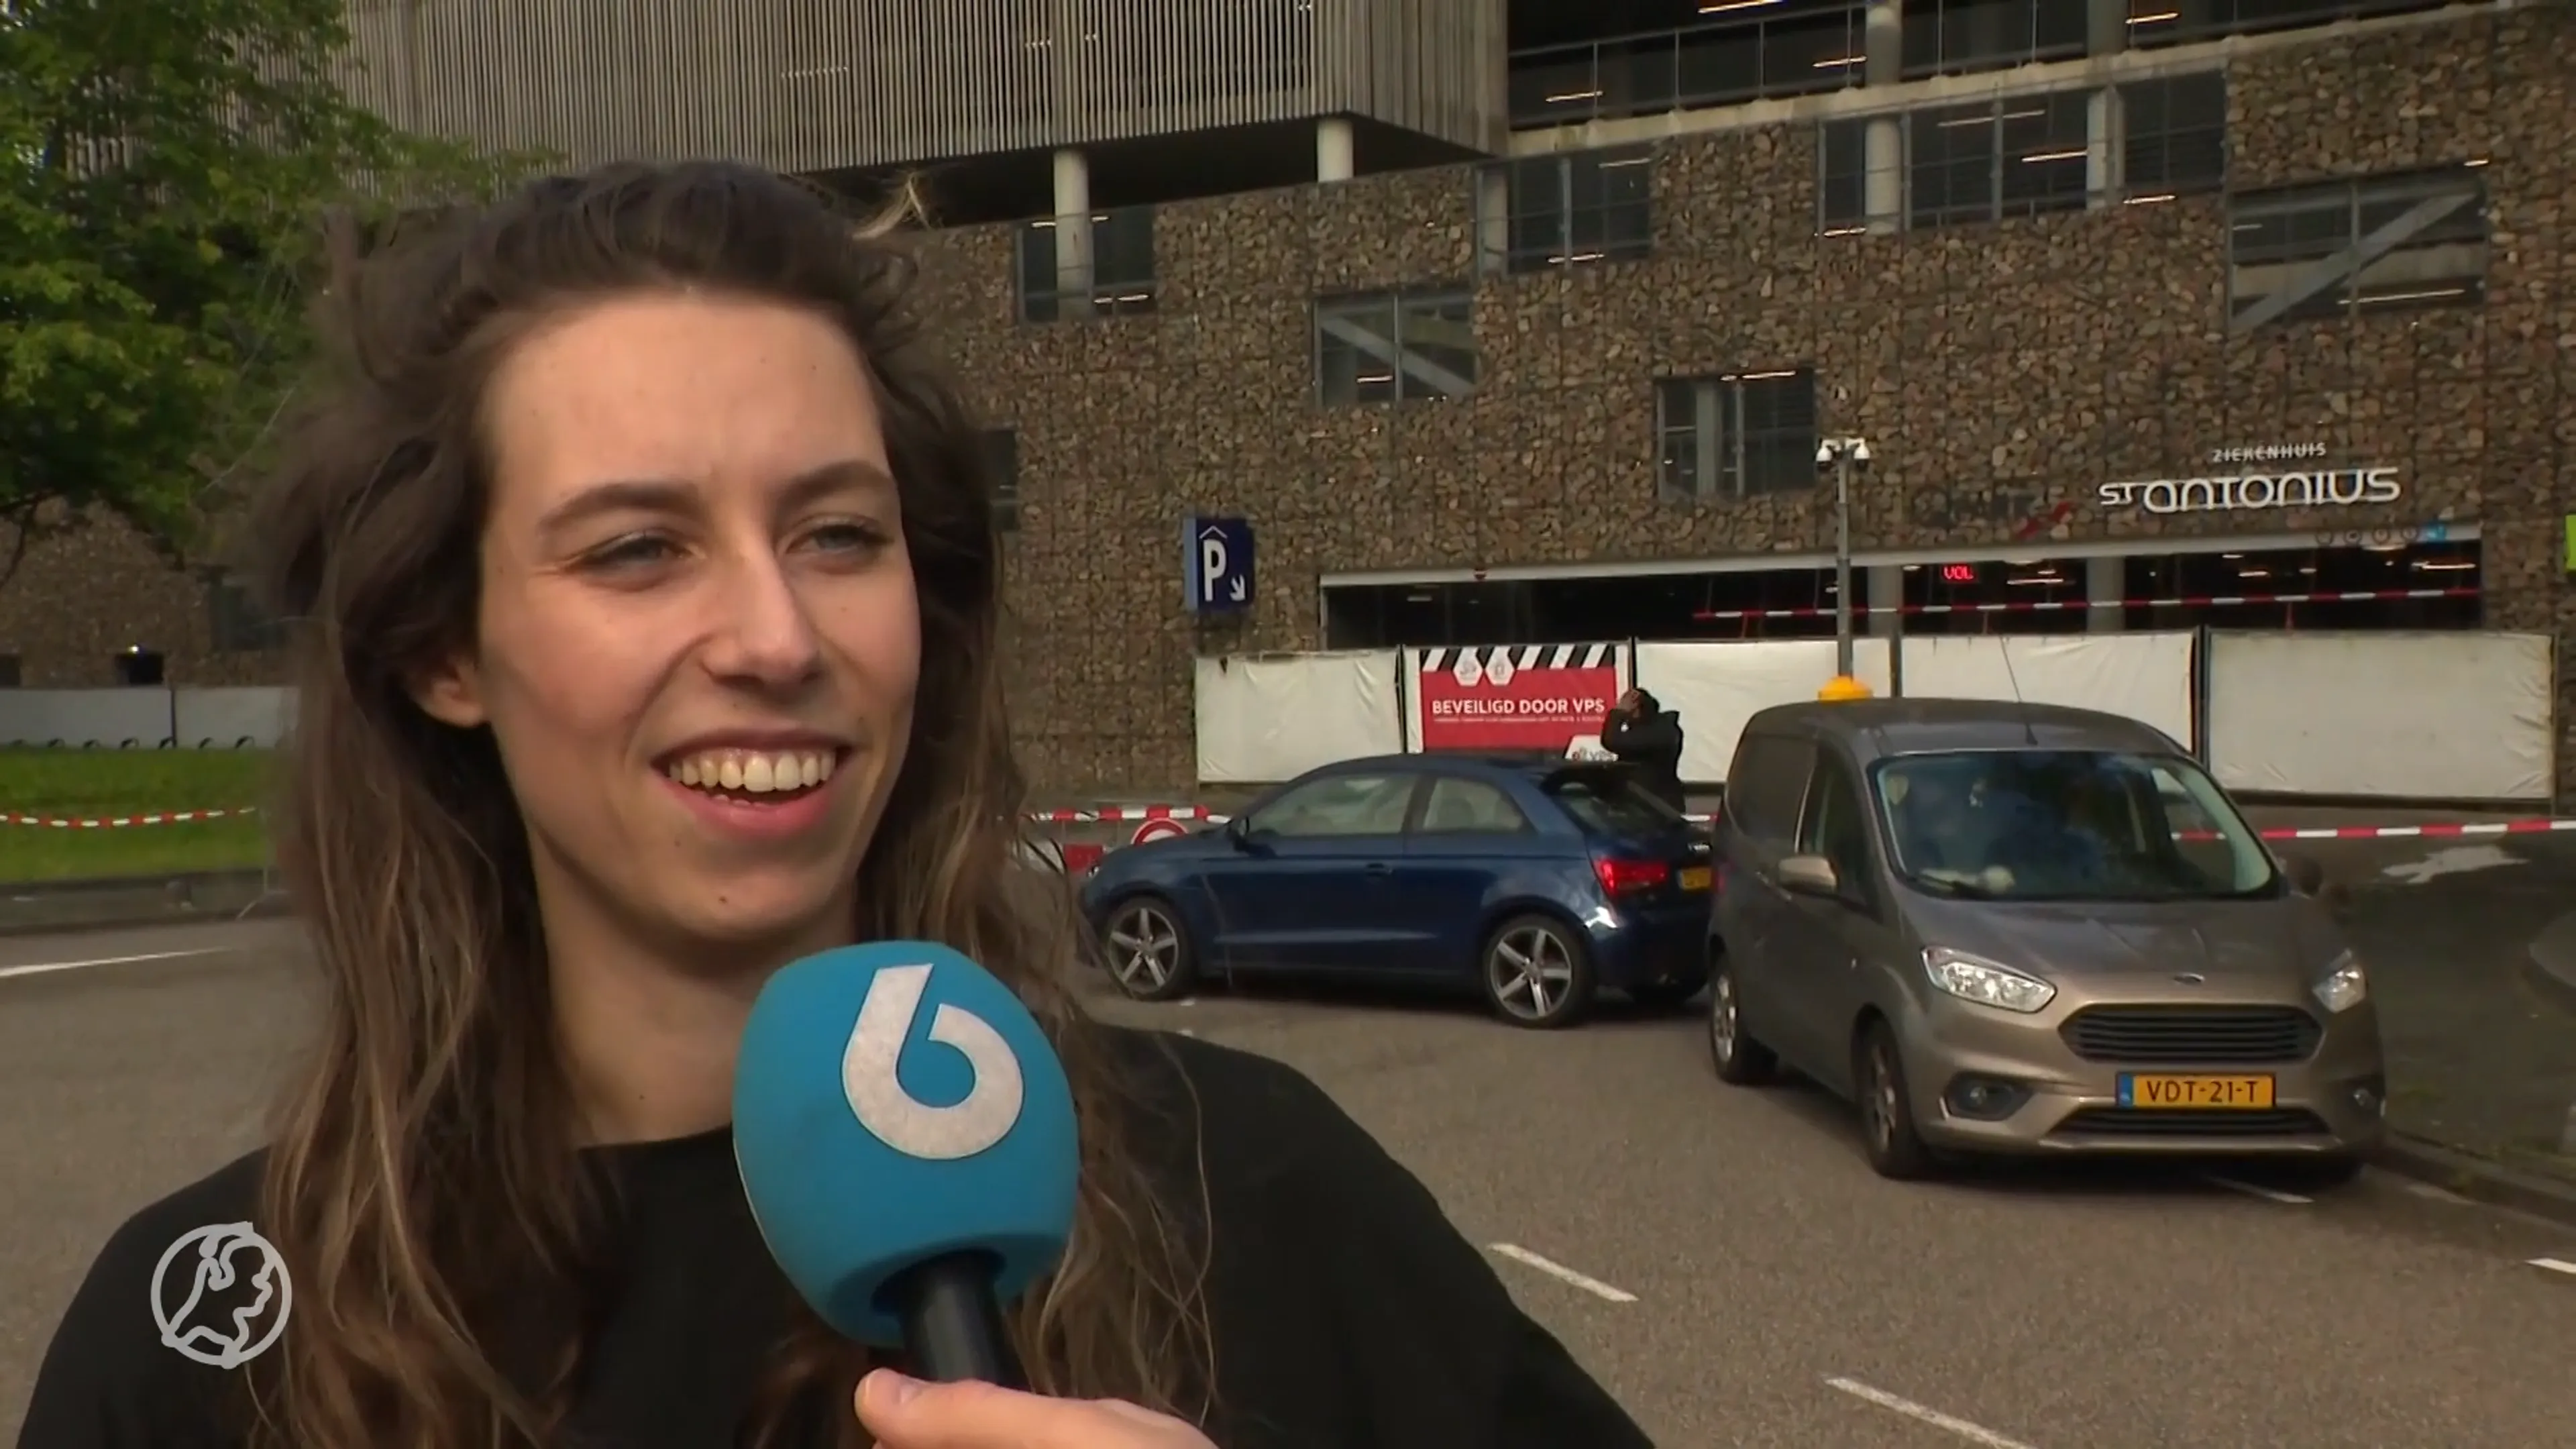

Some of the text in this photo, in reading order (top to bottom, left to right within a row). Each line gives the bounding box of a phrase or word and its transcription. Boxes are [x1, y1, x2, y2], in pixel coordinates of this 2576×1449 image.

[2212, 441, 2327, 464] ZIEKENHUIS
[1203, 539, 1227, 602] P
[1943, 565, 1974, 580] VOL
[1432, 696, 1605, 714] BEVEILIGD DOOR VPS
[842, 963, 1024, 1160] 6
[2146, 1079, 2259, 1103] VDT-21-T
